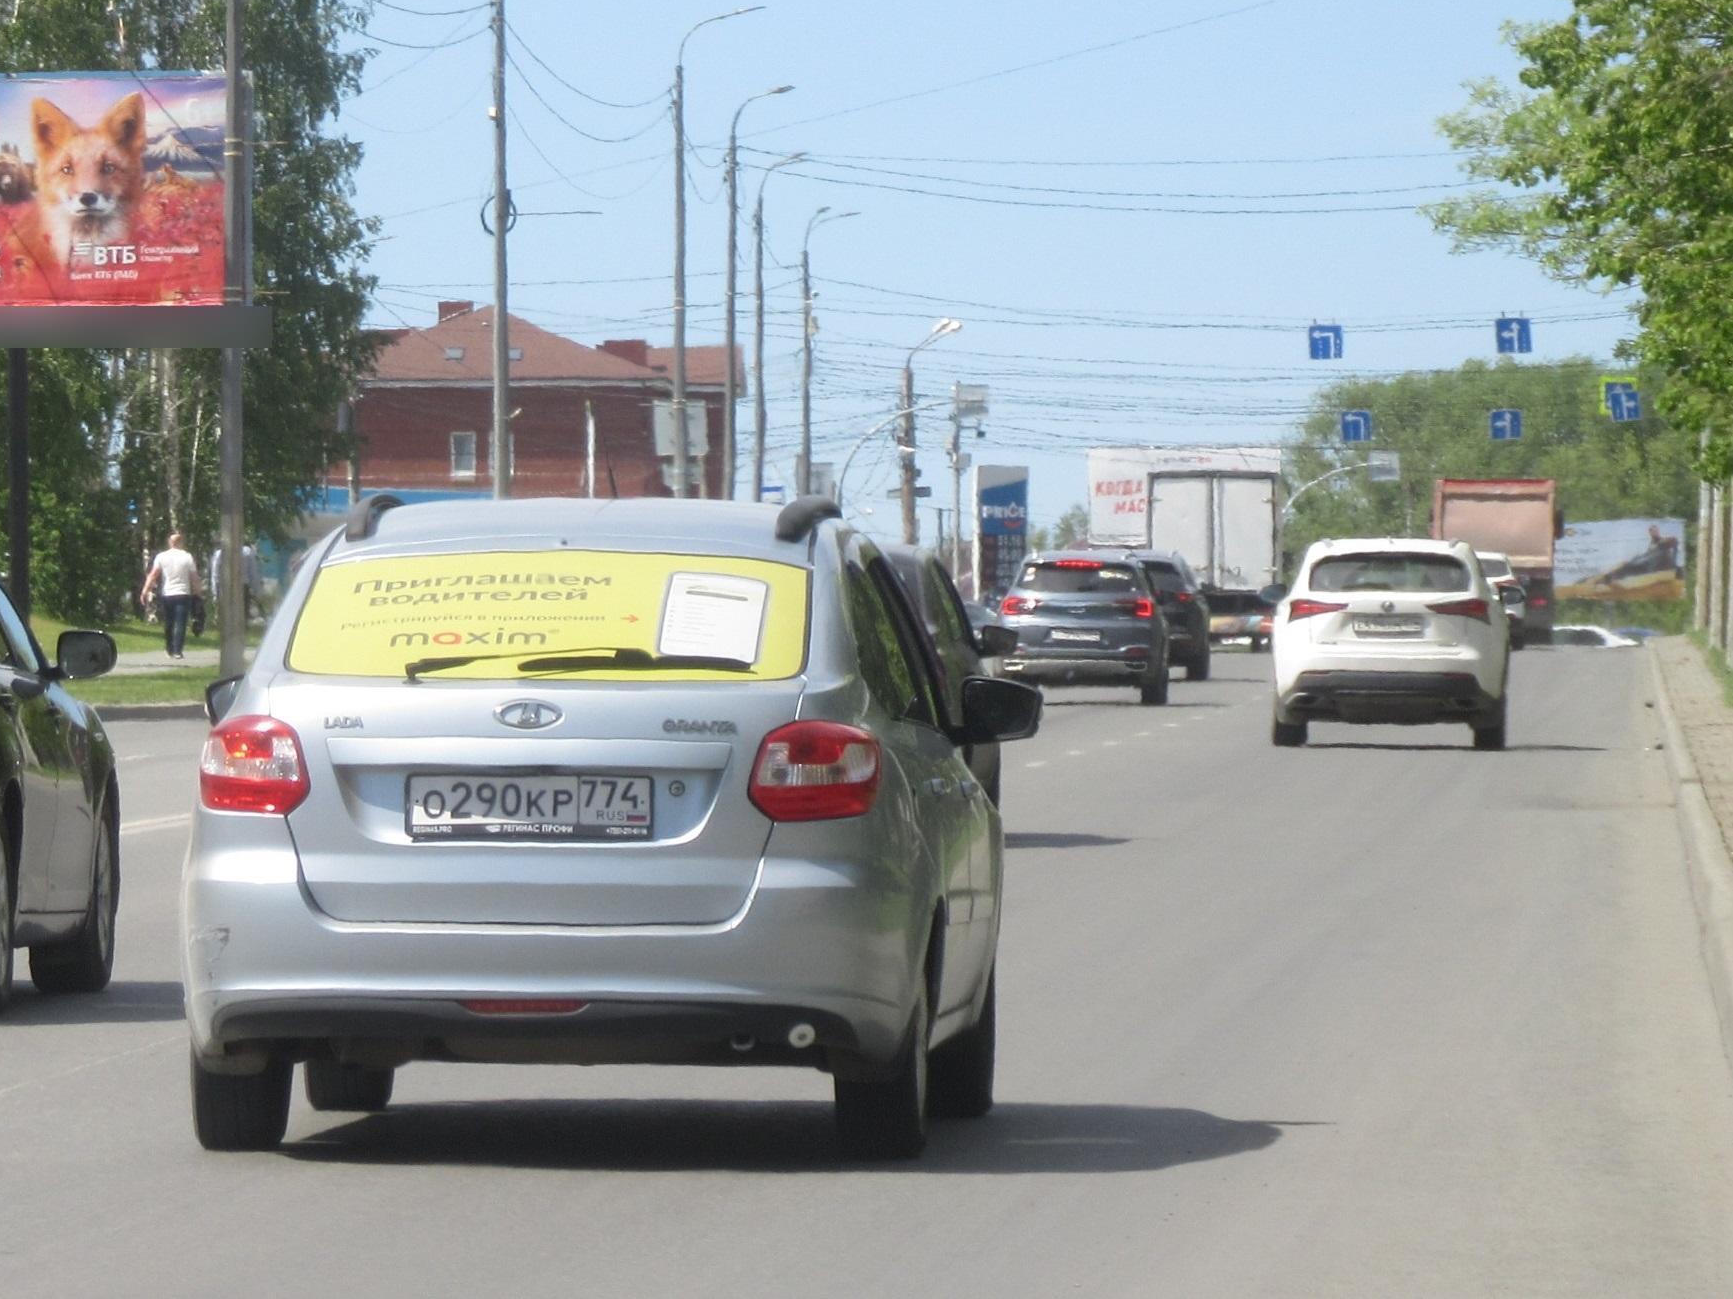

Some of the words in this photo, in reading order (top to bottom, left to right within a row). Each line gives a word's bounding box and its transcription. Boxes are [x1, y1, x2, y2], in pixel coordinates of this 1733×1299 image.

[93, 245, 137, 265] ВТБ
[981, 501, 1027, 519] PRICE
[353, 573, 613, 594] Приглашаем
[368, 588, 589, 607] водителей
[389, 628, 548, 648] maxim
[323, 716, 365, 730] LADA
[662, 719, 739, 735] GRANTA
[581, 780, 639, 809] 774
[595, 810, 626, 822] RUS
[541, 825, 574, 834] ПРОФИ
